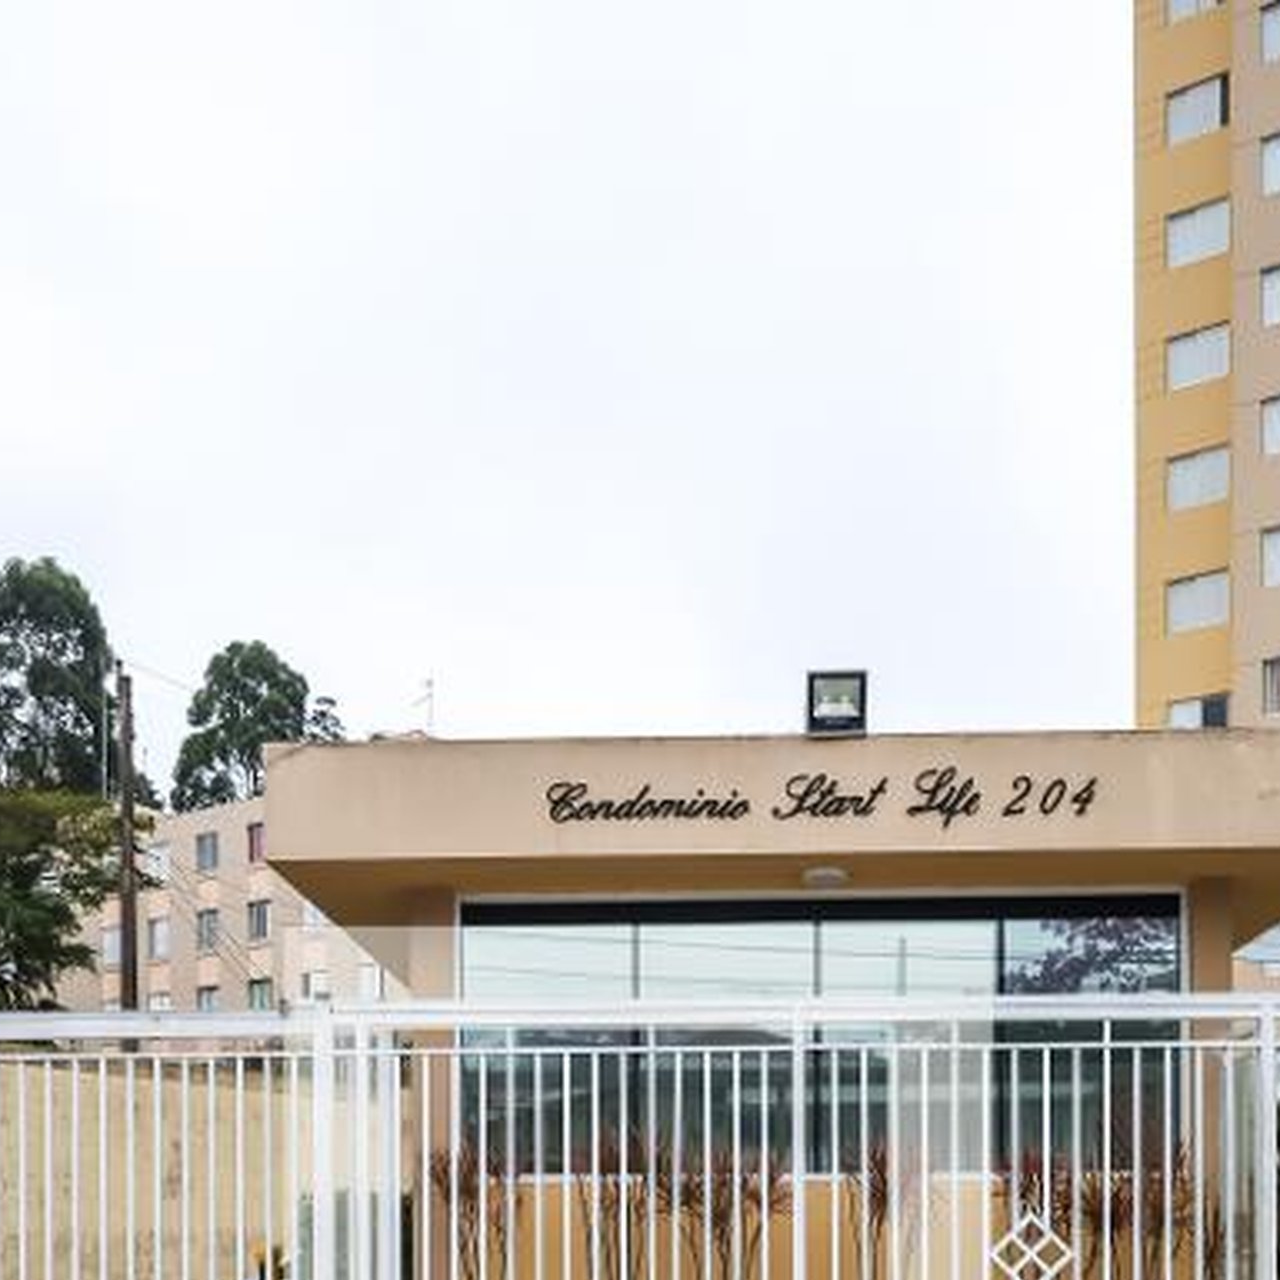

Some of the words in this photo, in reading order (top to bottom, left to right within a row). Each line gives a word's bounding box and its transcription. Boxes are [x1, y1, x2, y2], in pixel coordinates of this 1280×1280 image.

[545, 782, 750, 823] Condominio
[771, 773, 888, 820] Start
[906, 766, 981, 828] Life
[1001, 775, 1097, 817] 204
